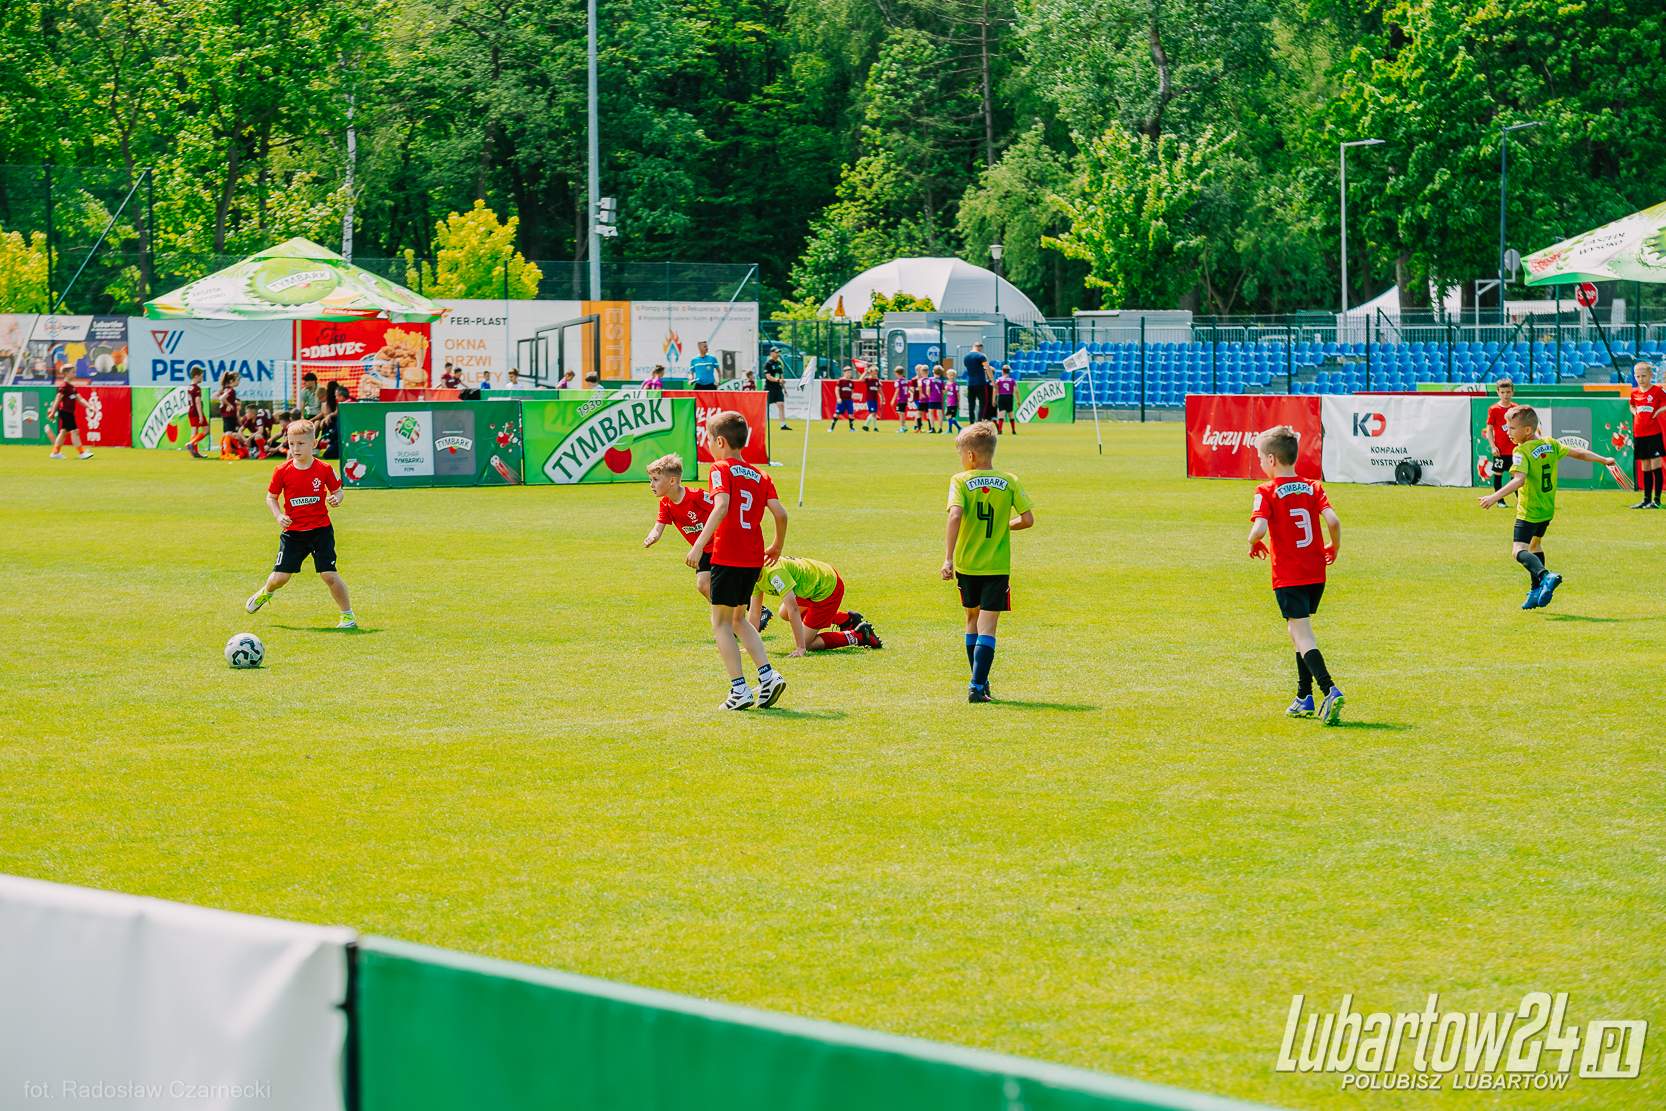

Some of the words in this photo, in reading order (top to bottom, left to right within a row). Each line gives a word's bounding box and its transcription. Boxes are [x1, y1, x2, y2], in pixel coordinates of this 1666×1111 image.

[450, 316, 508, 326] FER-PLAST
[444, 338, 487, 350] OKNA
[444, 355, 492, 367] DRZWI
[1019, 381, 1064, 421] TYMBARK
[144, 389, 188, 446] TYMBAR
[1352, 412, 1387, 437] KD
[437, 437, 470, 449] TYMBARK
[551, 398, 666, 481] TYMBARK
[1202, 424, 1242, 454] Łączy
[1370, 446, 1408, 455] KOMPANIA
[1494, 458, 1503, 469] 23
[969, 477, 1006, 490] TYMBARK
[1541, 463, 1553, 493] 6
[740, 489, 753, 529] 2
[976, 501, 995, 538] 4
[1289, 508, 1313, 548] 3
